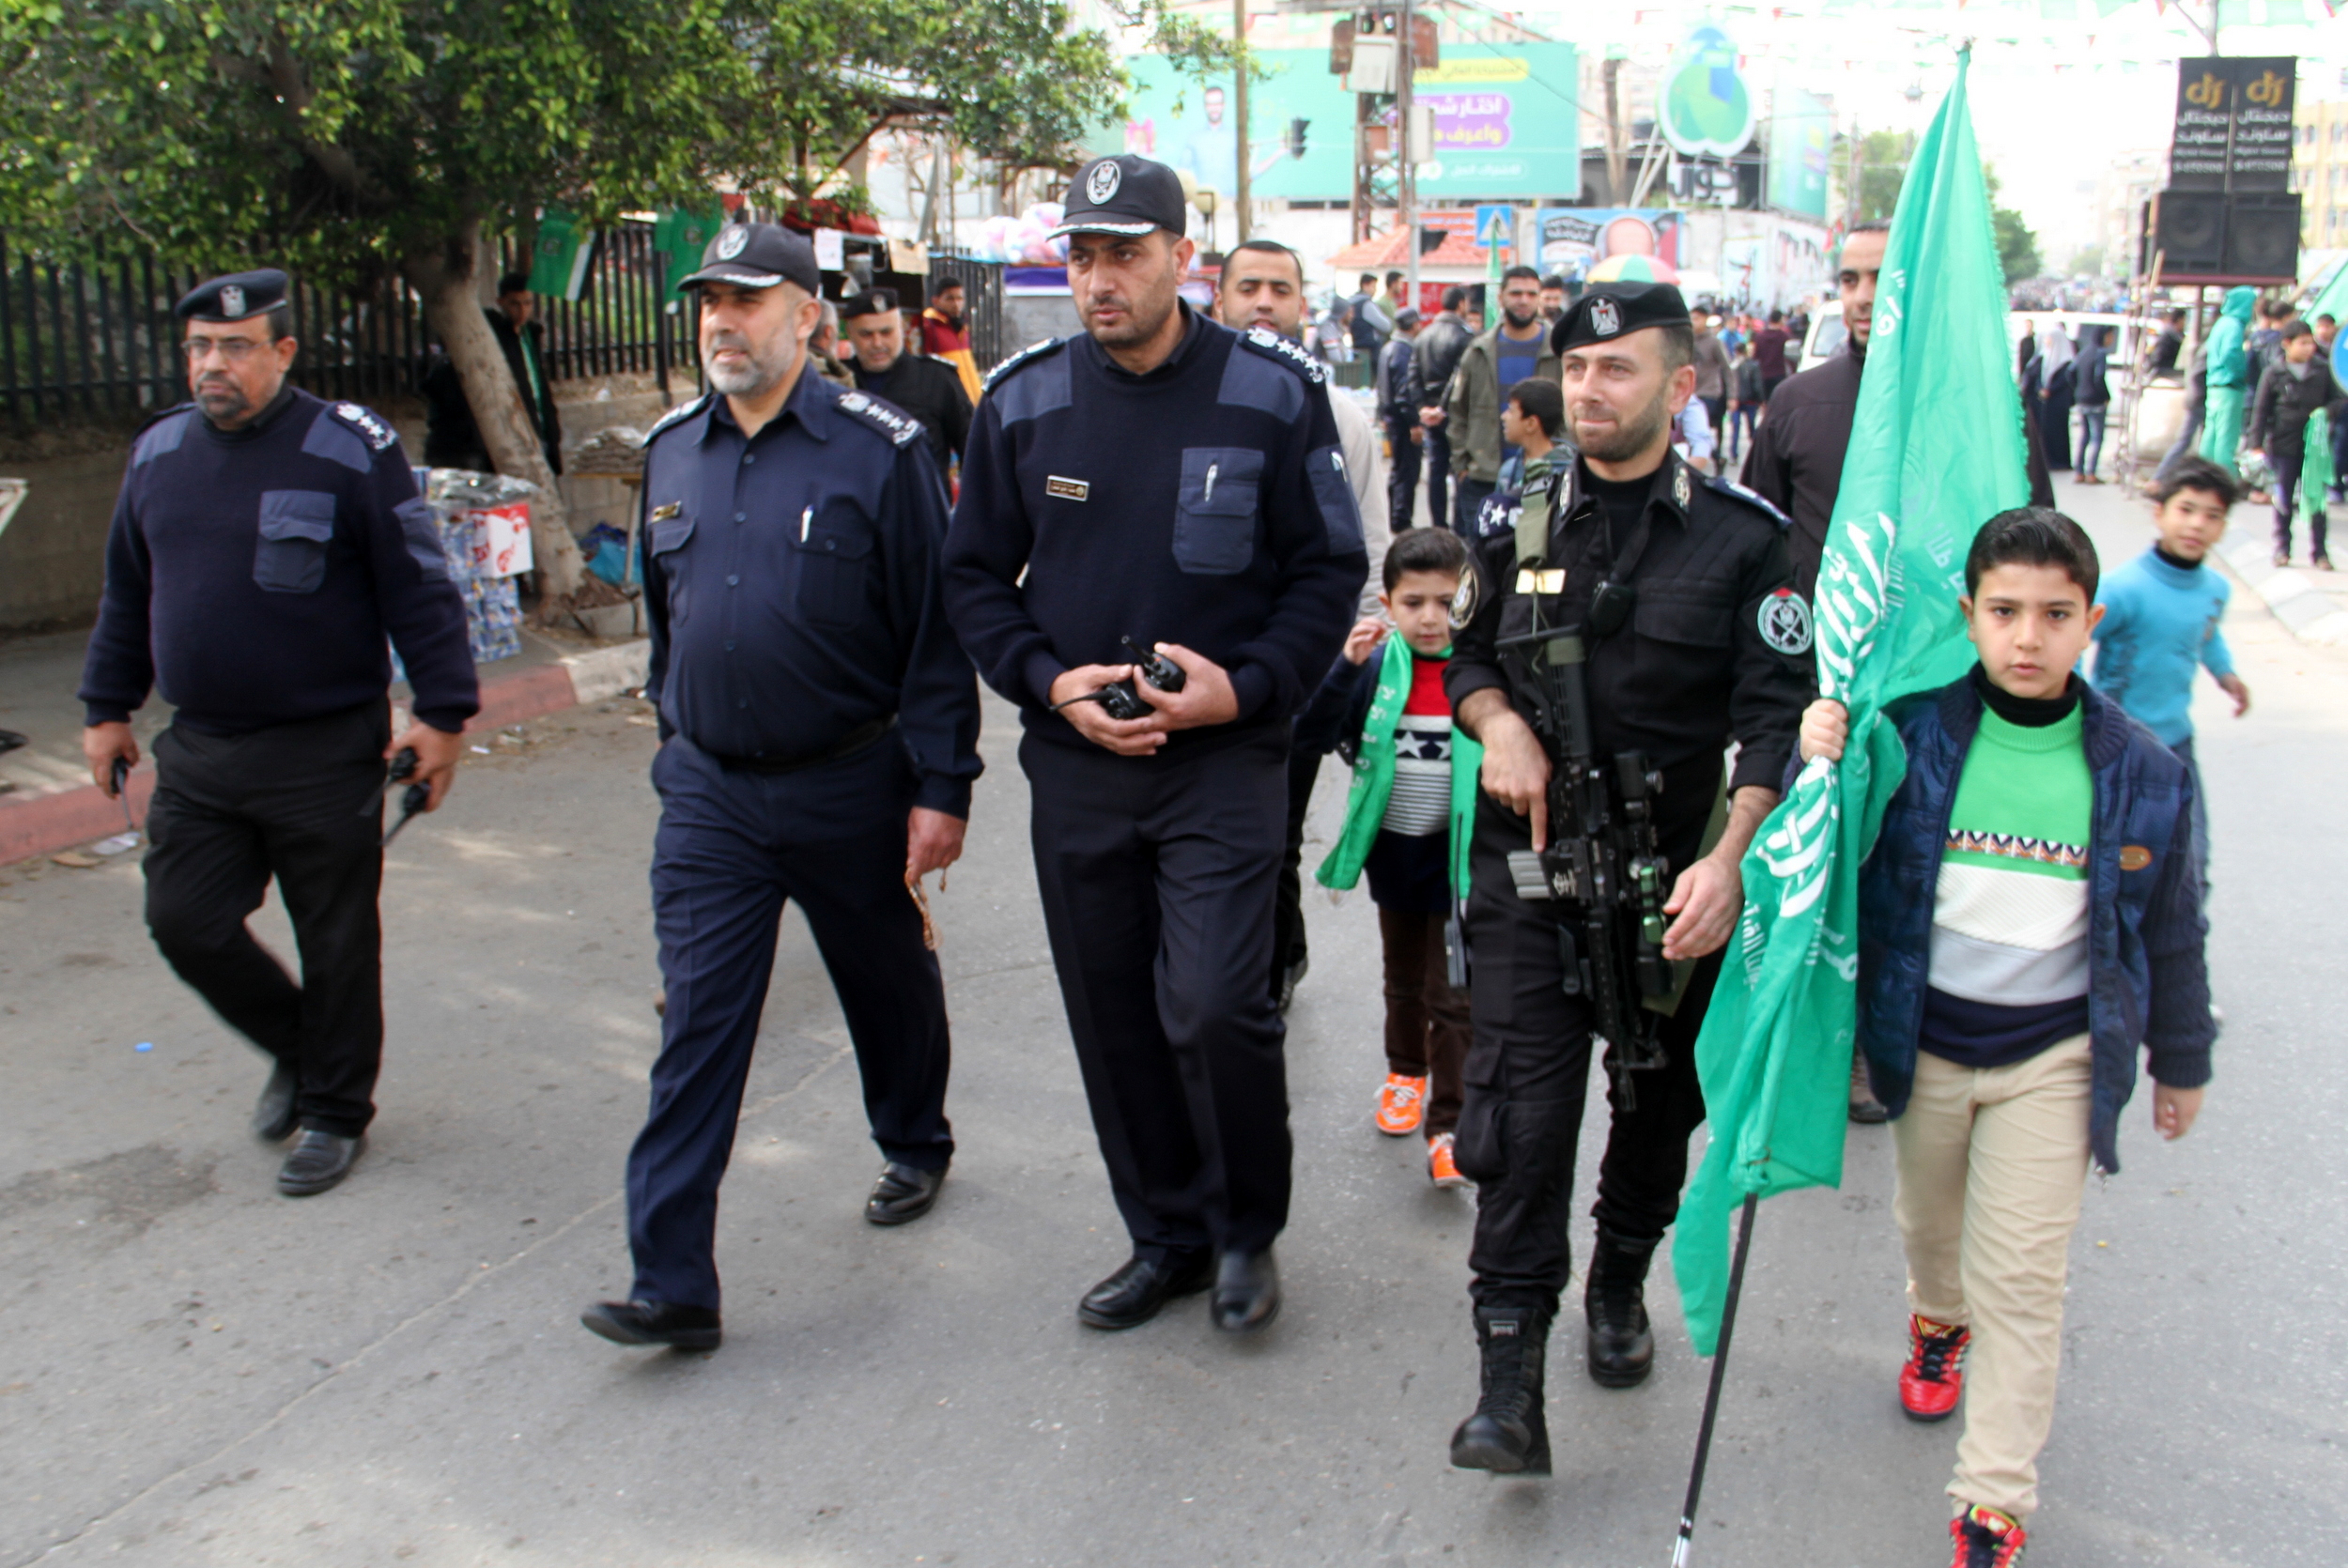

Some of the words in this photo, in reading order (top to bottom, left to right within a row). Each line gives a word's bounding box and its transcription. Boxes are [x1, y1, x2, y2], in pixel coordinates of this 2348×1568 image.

[2186, 71, 2226, 109] dj
[2246, 69, 2286, 107] dj
[1667, 166, 1737, 201] جوال
